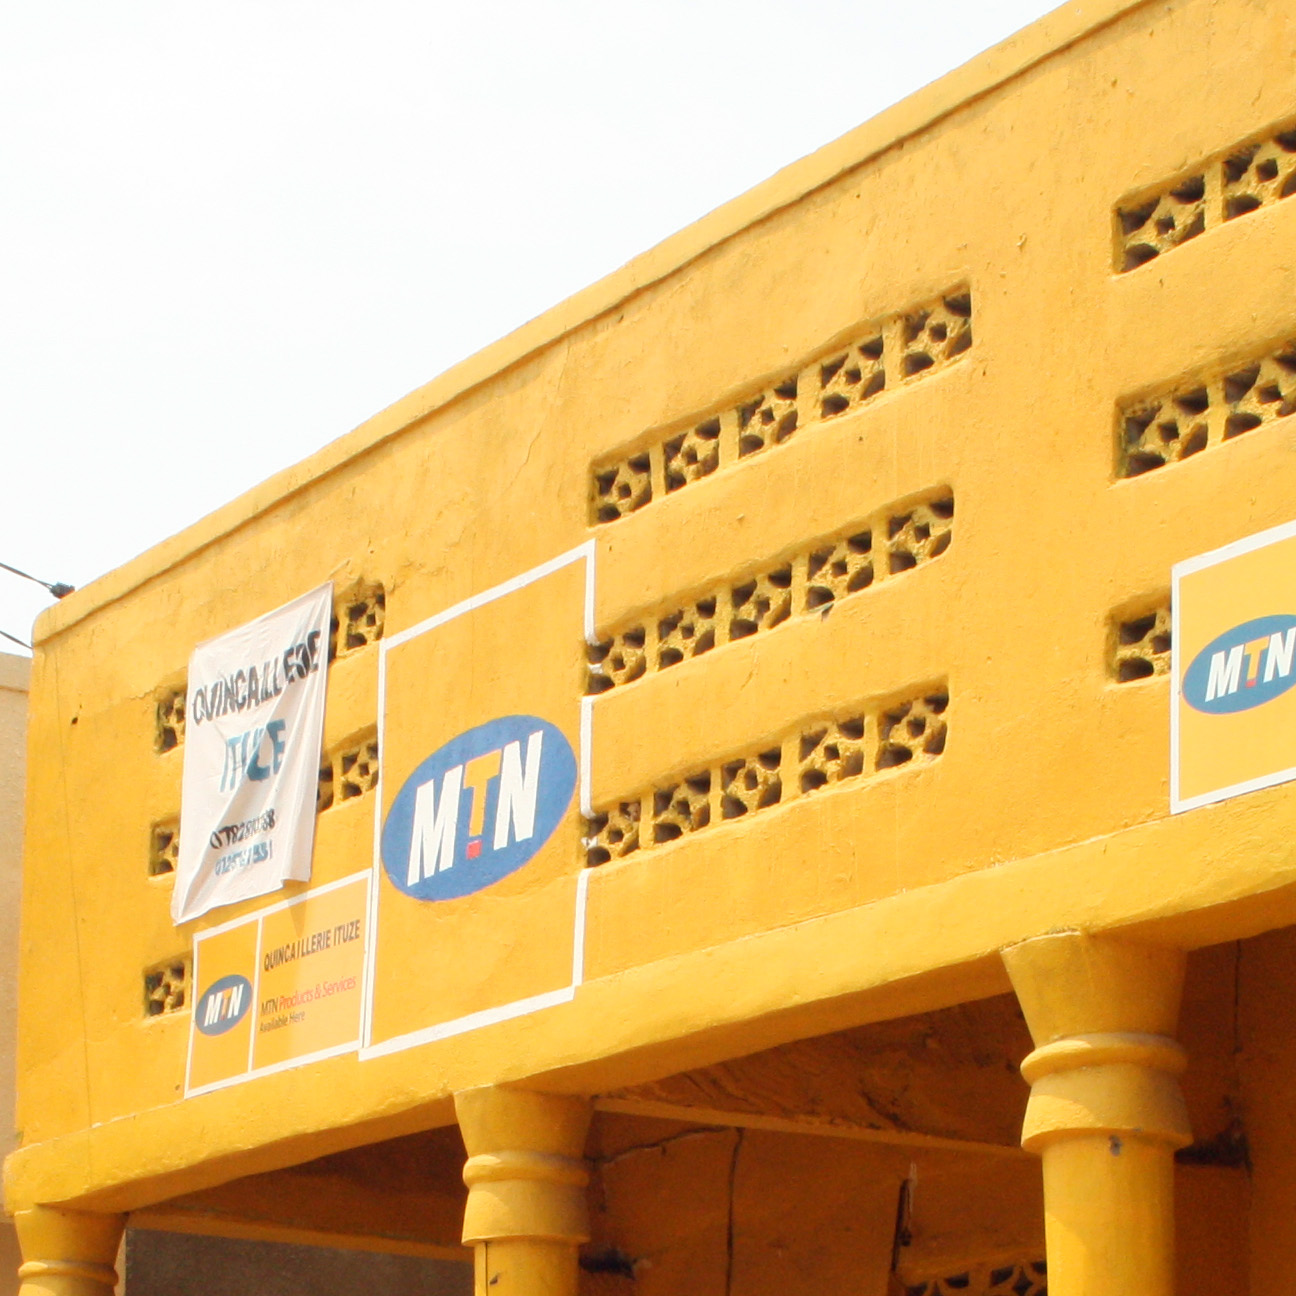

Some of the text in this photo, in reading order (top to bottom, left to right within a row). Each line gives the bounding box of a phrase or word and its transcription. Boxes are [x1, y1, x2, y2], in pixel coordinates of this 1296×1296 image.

[407, 729, 544, 888] MTN
[263, 919, 361, 972] QUINCAILLERIE ITUZE
[204, 983, 245, 1027] MTN
[279, 986, 314, 1012] Products
[322, 975, 357, 998] Services
